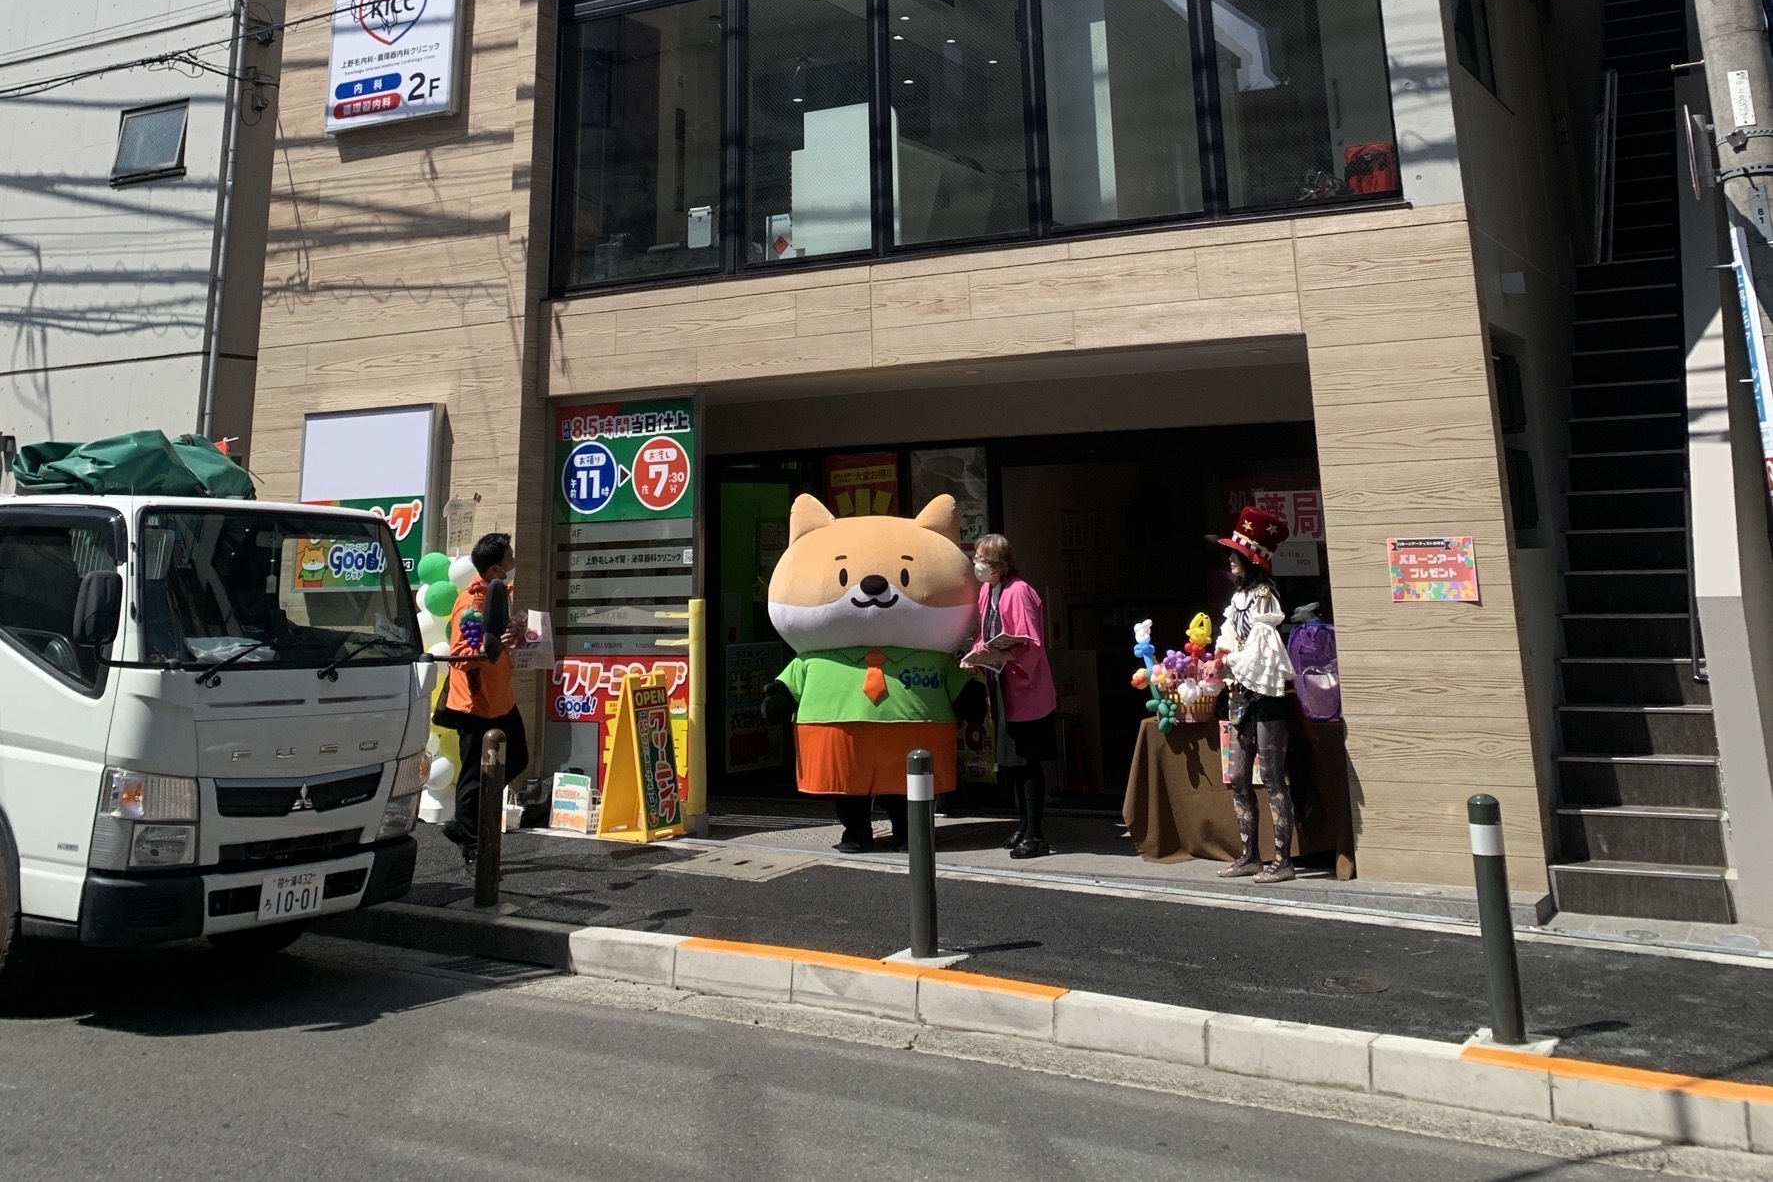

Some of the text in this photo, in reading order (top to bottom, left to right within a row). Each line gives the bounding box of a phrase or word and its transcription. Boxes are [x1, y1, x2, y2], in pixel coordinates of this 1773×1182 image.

[341, 42, 440, 69] 上野毛内科・循環器内科クリニック
[353, 78, 383, 95] 内科
[408, 71, 441, 102] 2F
[343, 96, 391, 116] 循環器内科
[579, 455, 602, 466] お預り
[649, 449, 671, 461] お渡し
[571, 529, 582, 539] 4F
[571, 556, 582, 566] 3F
[1398, 553, 1465, 565] バルーンアート
[570, 584, 580, 594] 2F
[634, 688, 667, 708] OPEN
[231, 740, 379, 762] FUSO
[648, 708, 680, 824] クリーニング
